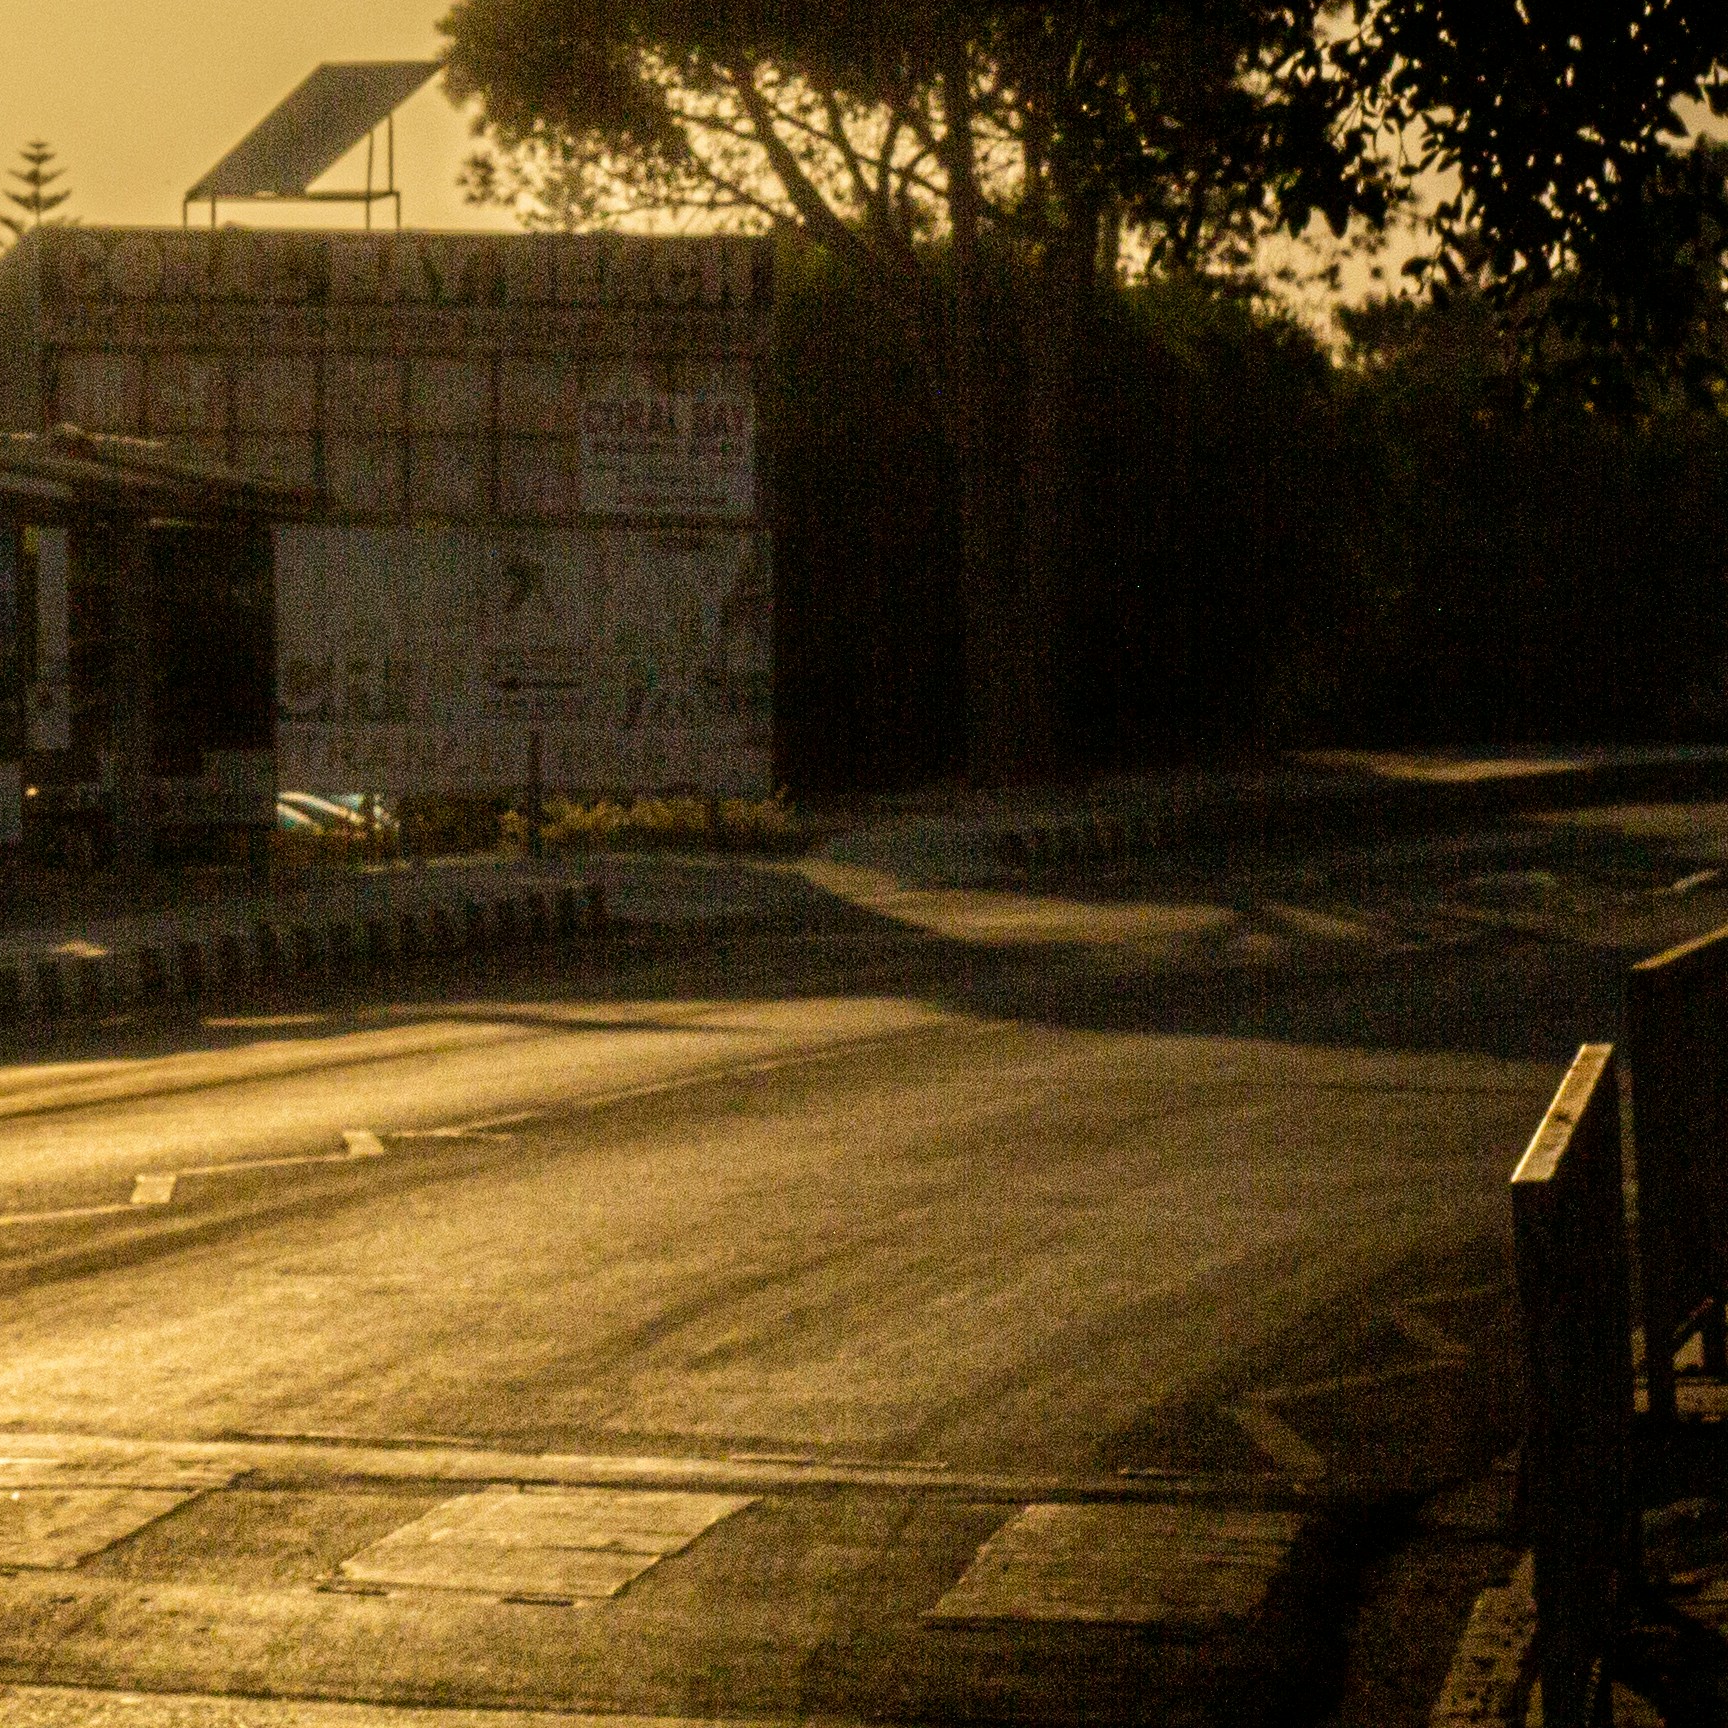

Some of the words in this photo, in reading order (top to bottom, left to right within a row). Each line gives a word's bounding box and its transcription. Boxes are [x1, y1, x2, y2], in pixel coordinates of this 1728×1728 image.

[59, 235, 309, 299] CORAL
[330, 238, 473, 302] BAY
[505, 239, 753, 303] BEACH
[585, 399, 679, 437] CORAL
[692, 400, 746, 439] BAY
